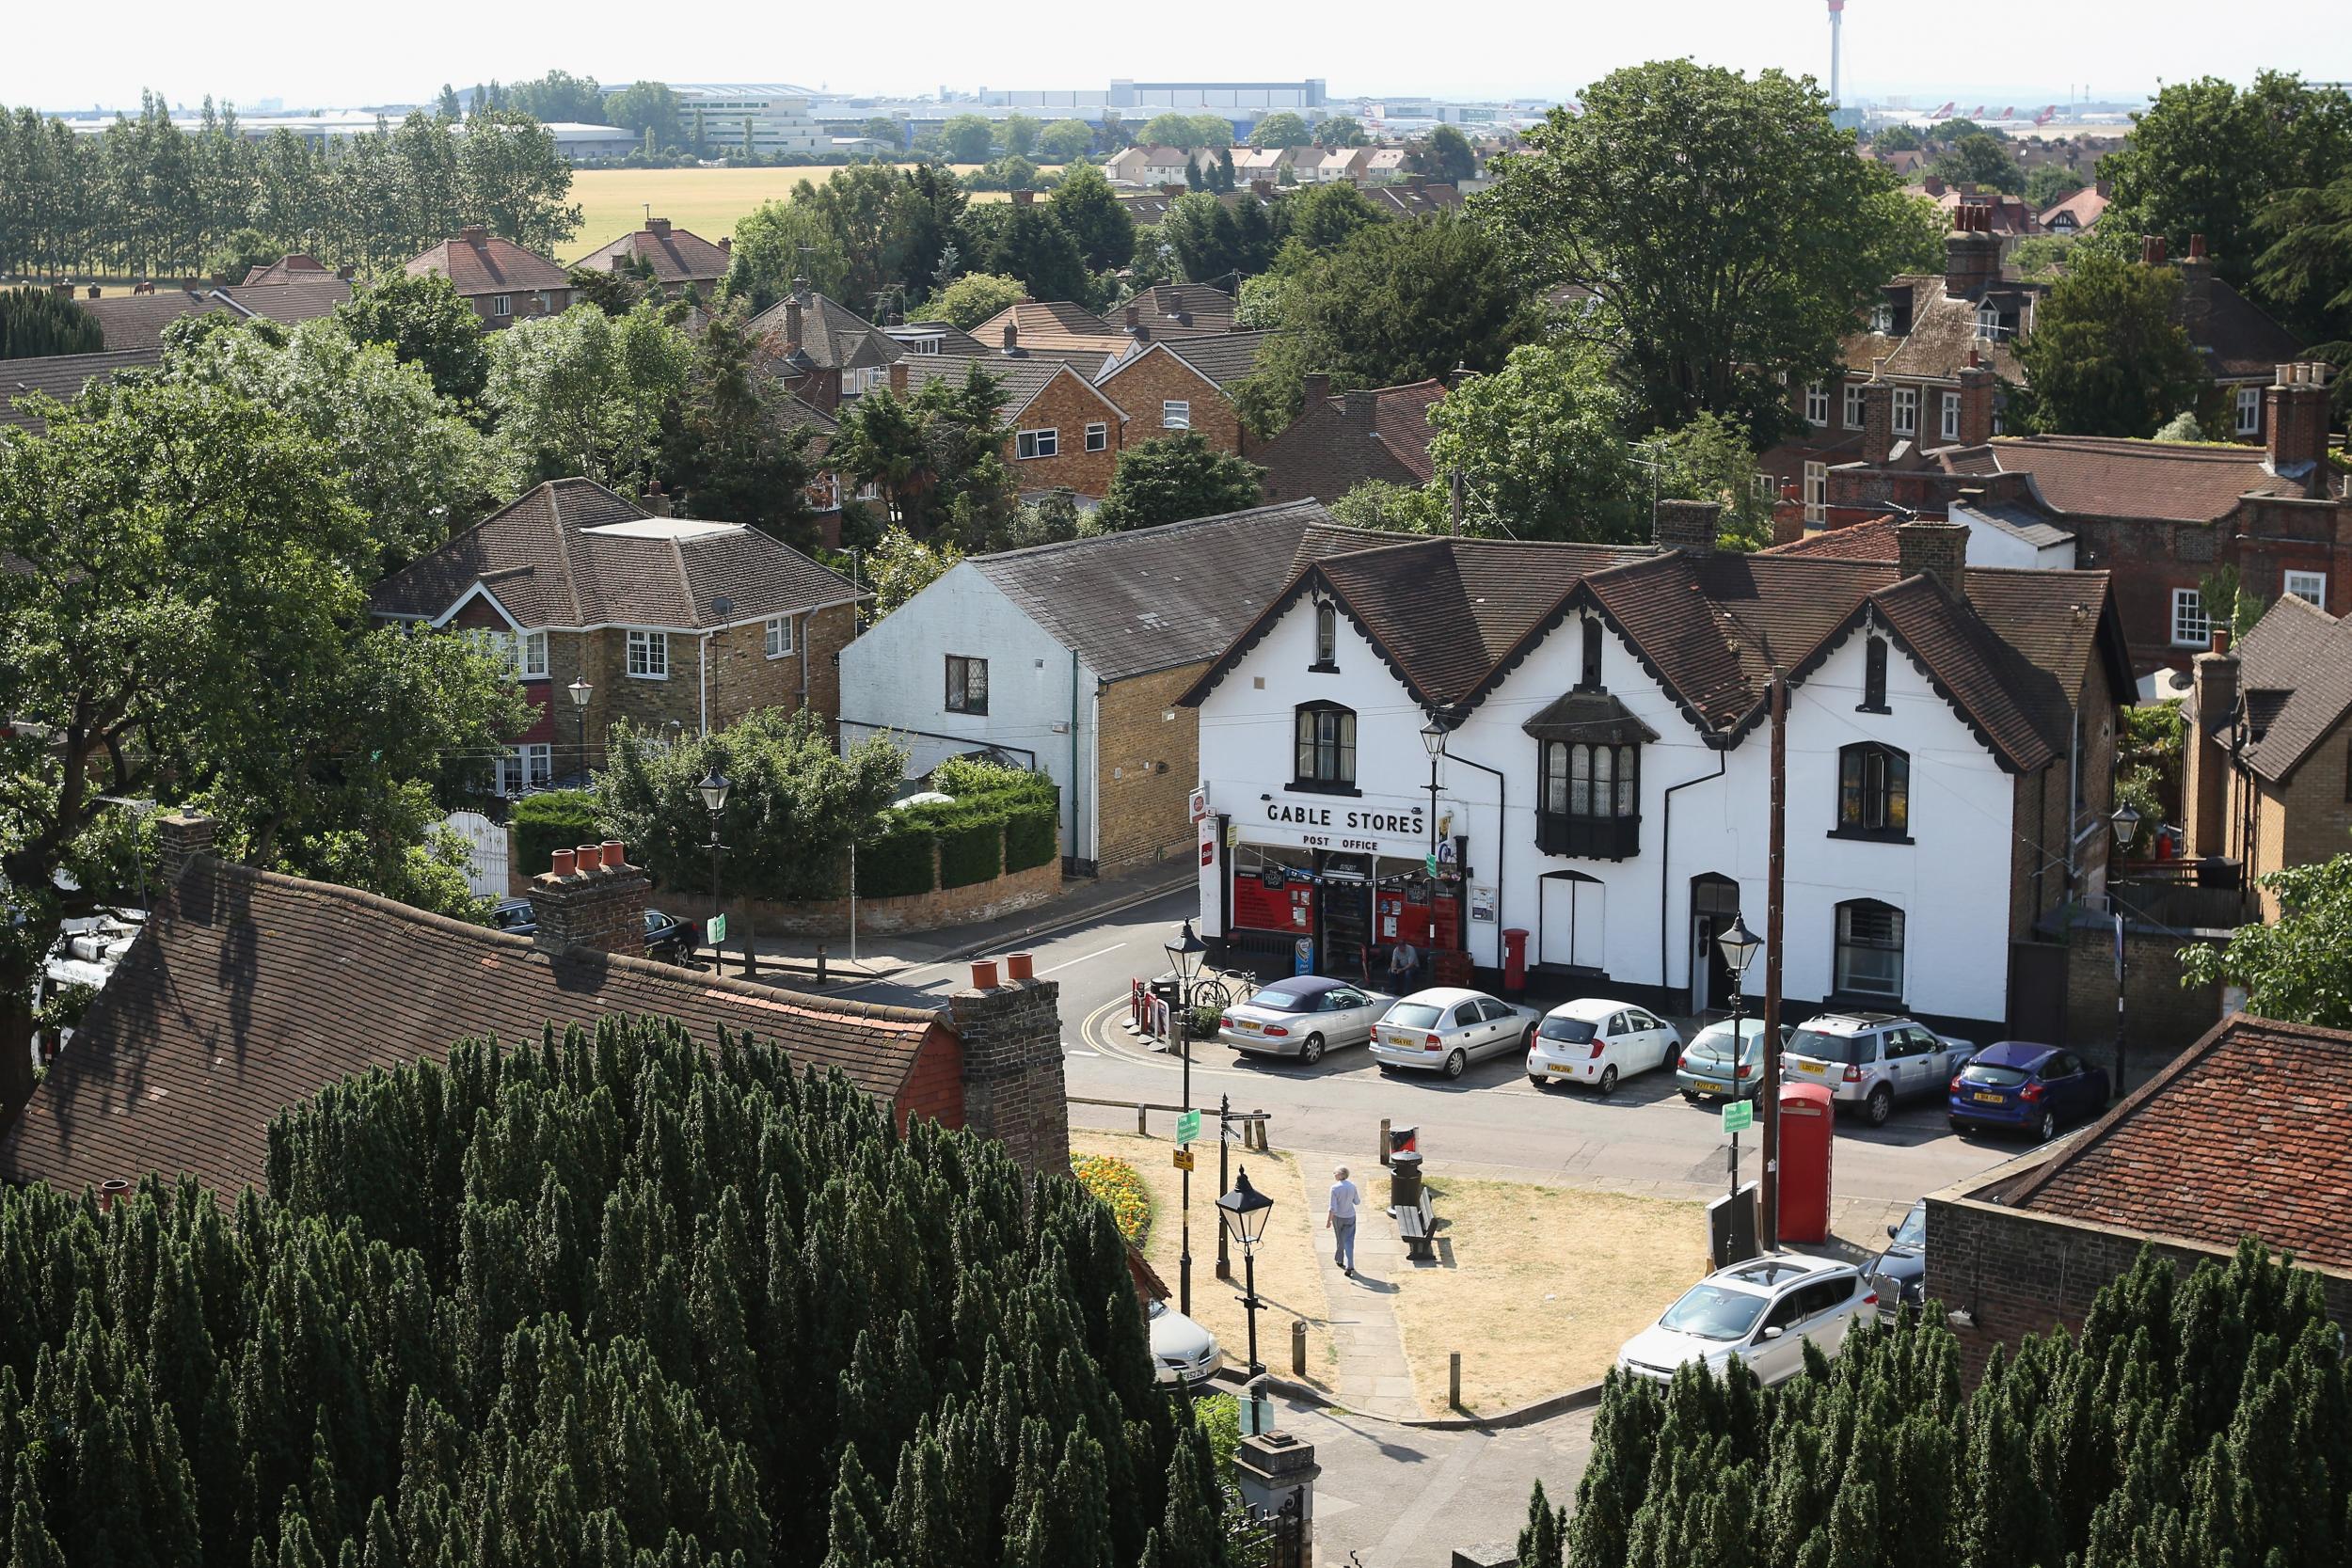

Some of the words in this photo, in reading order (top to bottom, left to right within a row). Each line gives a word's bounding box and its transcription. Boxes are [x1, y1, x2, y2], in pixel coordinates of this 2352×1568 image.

[1267, 804, 1331, 826] GABLE
[1347, 812, 1423, 834] STORES
[1303, 835, 1329, 846] POST
[1343, 839, 1378, 850] OFFICE
